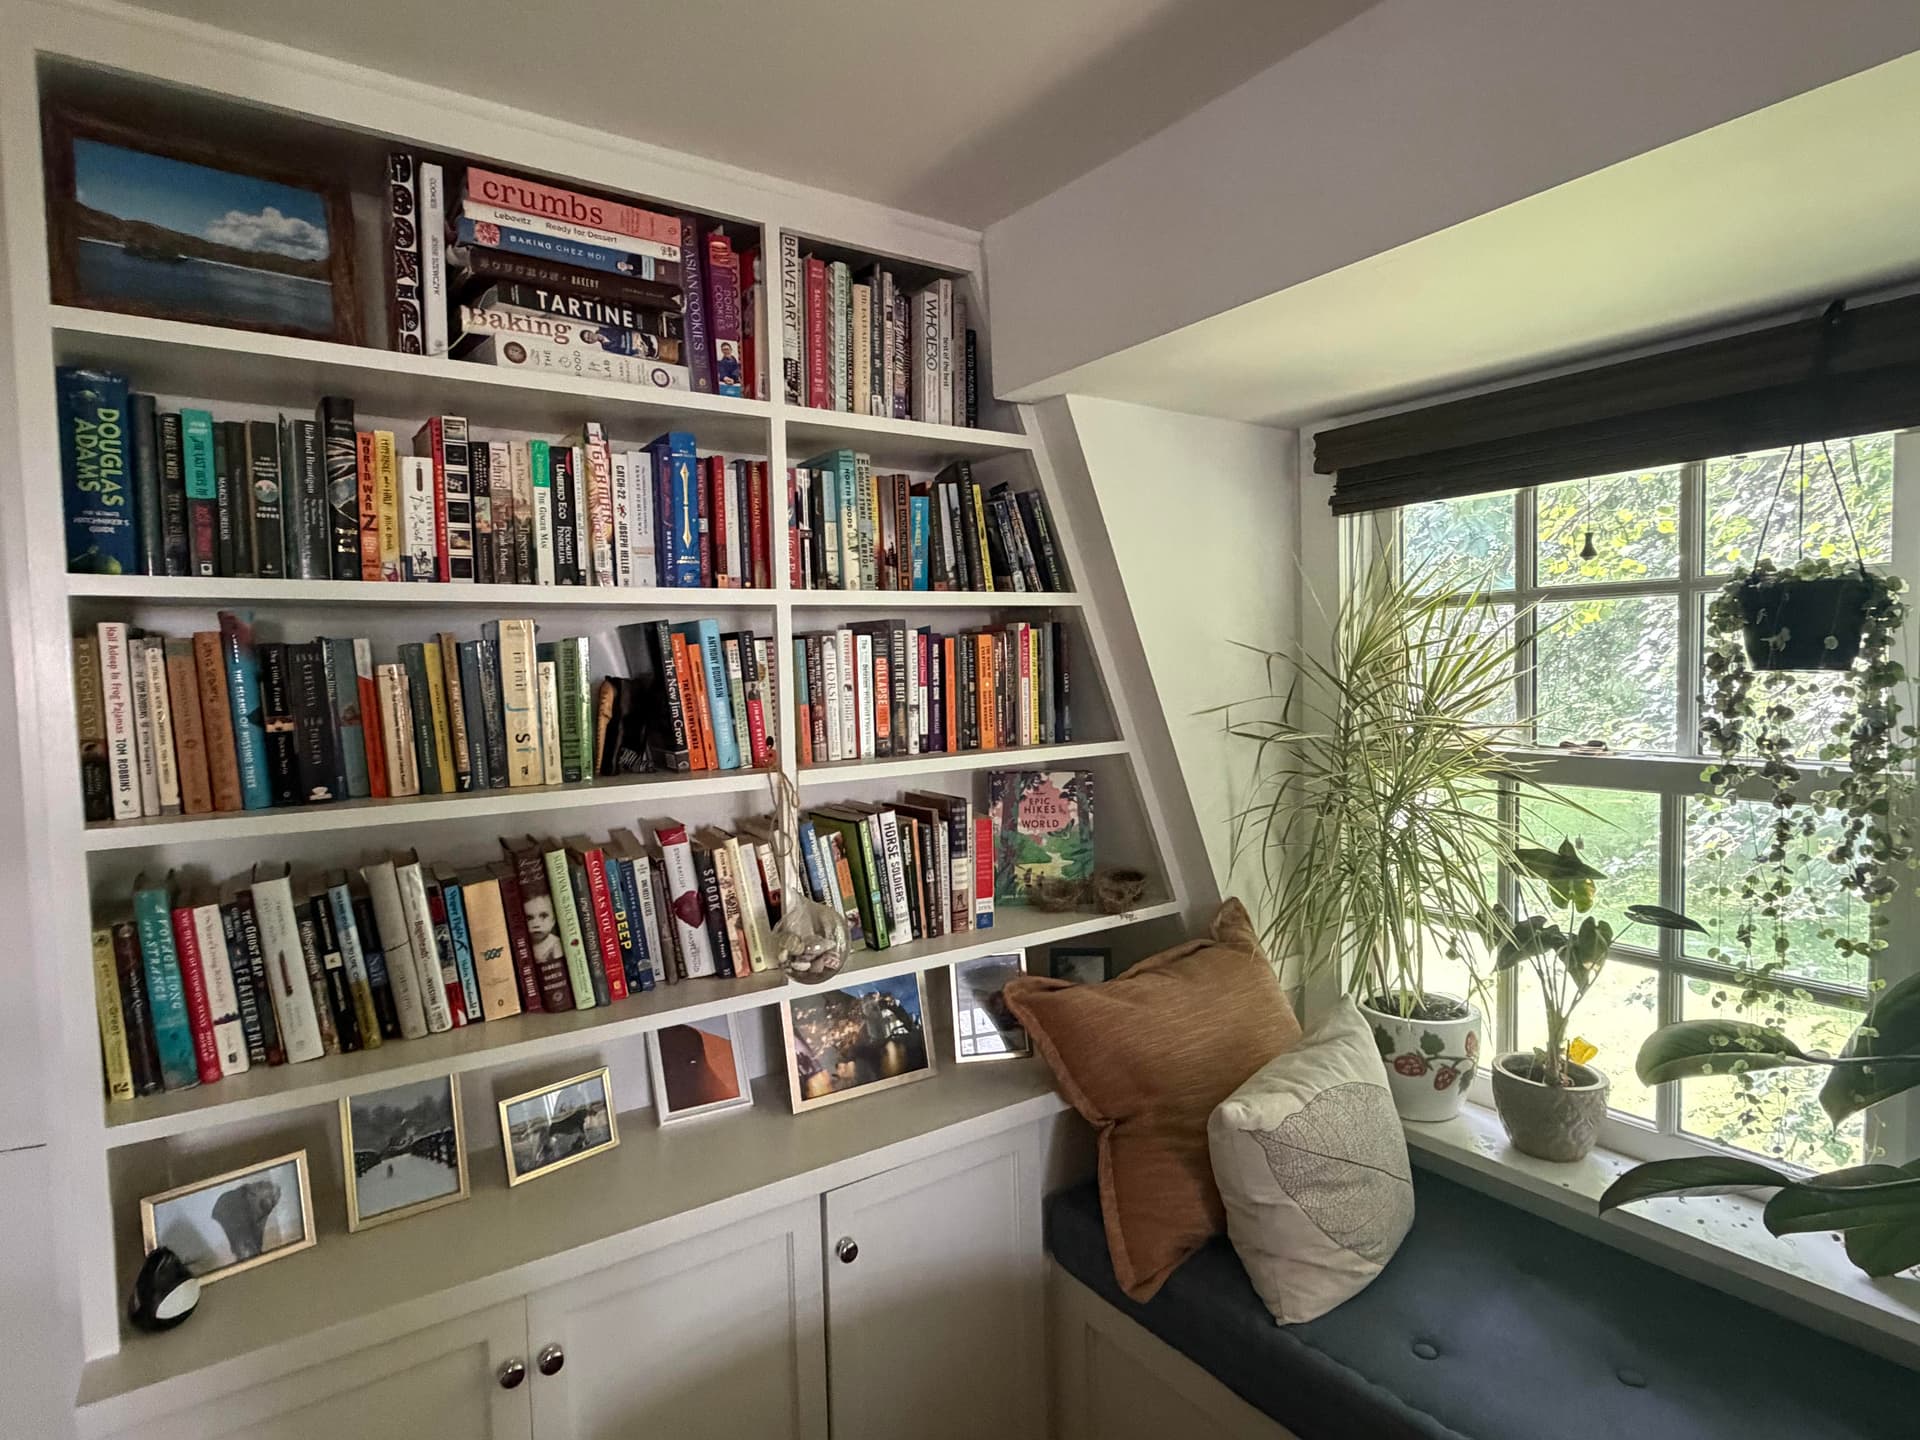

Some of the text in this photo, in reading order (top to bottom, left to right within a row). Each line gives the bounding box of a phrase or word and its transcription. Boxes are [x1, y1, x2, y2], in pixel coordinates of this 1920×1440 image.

[483, 180, 604, 225] crumbs
[494, 211, 532, 226] Lebovitz
[510, 235, 583, 258] BAKING CHEZ
[545, 222, 618, 244] Ready for Dessert
[571, 275, 600, 288] BAKERY
[685, 250, 706, 351] ASIAN COOKIES
[785, 236, 797, 331] BRAVETART
[467, 308, 571, 345] Baking
[536, 290, 634, 329] TARTINE
[926, 299, 938, 371] WHOLE30
[543, 351, 551, 367] THE
[603, 360, 611, 378] LAB
[74, 417, 101, 492] ADAMS
[97, 407, 125, 507] DOUGLAS
[304, 423, 316, 494] Richard Brautigan
[491, 446, 508, 489] Ireland
[437, 464, 445, 507] FLORIDA
[593, 431, 613, 525] TIGERMAN
[634, 464, 642, 491] ERNEST
[844, 468, 852, 497] NORTH
[218, 476, 230, 541] MARCUS AURELIUS
[538, 491, 549, 550] THE GINGER MAN
[616, 464, 631, 575] CATCH-22 JOSEPH HELLER
[753, 497, 762, 530] MANTEL
[900, 509, 909, 545] MADELINE
[498, 526, 509, 575] Frank Delaney
[519, 526, 529, 568] Tipperary
[270, 649, 279, 663] The
[664, 657, 676, 676] The
[707, 635, 719, 664] ANTHONY
[746, 647, 754, 666] GOOD
[893, 629, 906, 703] CATHERINE THE GREAT
[1022, 634, 1030, 674] SAPIENS
[234, 669, 244, 683] THE
[667, 678, 679, 700] New
[712, 666, 724, 698] BOURDAIN
[826, 662, 838, 705] HORSE
[876, 657, 889, 705] COLLAPSE
[106, 626, 131, 792] Half Asleep In Frog Pajamas TOM ROBBINS
[239, 716, 249, 728] OF
[669, 701, 683, 718] Jim
[682, 679, 700, 750] THE GREAT INFLUENZA
[752, 702, 761, 726] JIMMY
[240, 731, 253, 764] MISSING
[674, 719, 686, 746] Crow
[1023, 804, 1057, 814] HIKES
[1029, 797, 1051, 806] EPIC
[1021, 819, 1060, 829] WORLD
[553, 855, 570, 894] SURVIVAL
[672, 847, 683, 865] EVAN
[883, 820, 906, 904] HORSE SOLDIERS
[703, 867, 722, 912] SPOOK
[452, 916, 466, 940] Flights
[590, 860, 618, 960] COME AS YOU ARE
[157, 919, 178, 970] VOYAGE
[242, 910, 265, 978] THE GHOST MAP
[301, 920, 320, 975] Pathogenesis
[614, 910, 633, 950] DEEP
[143, 919, 169, 1001] AND STRANGE
[181, 911, 208, 1028] THE DEATH OF COMMON SENSE
[519, 949, 529, 960] SPY
[165, 975, 183, 1010] LONG
[236, 968, 267, 1063] FEATHER THIEF
